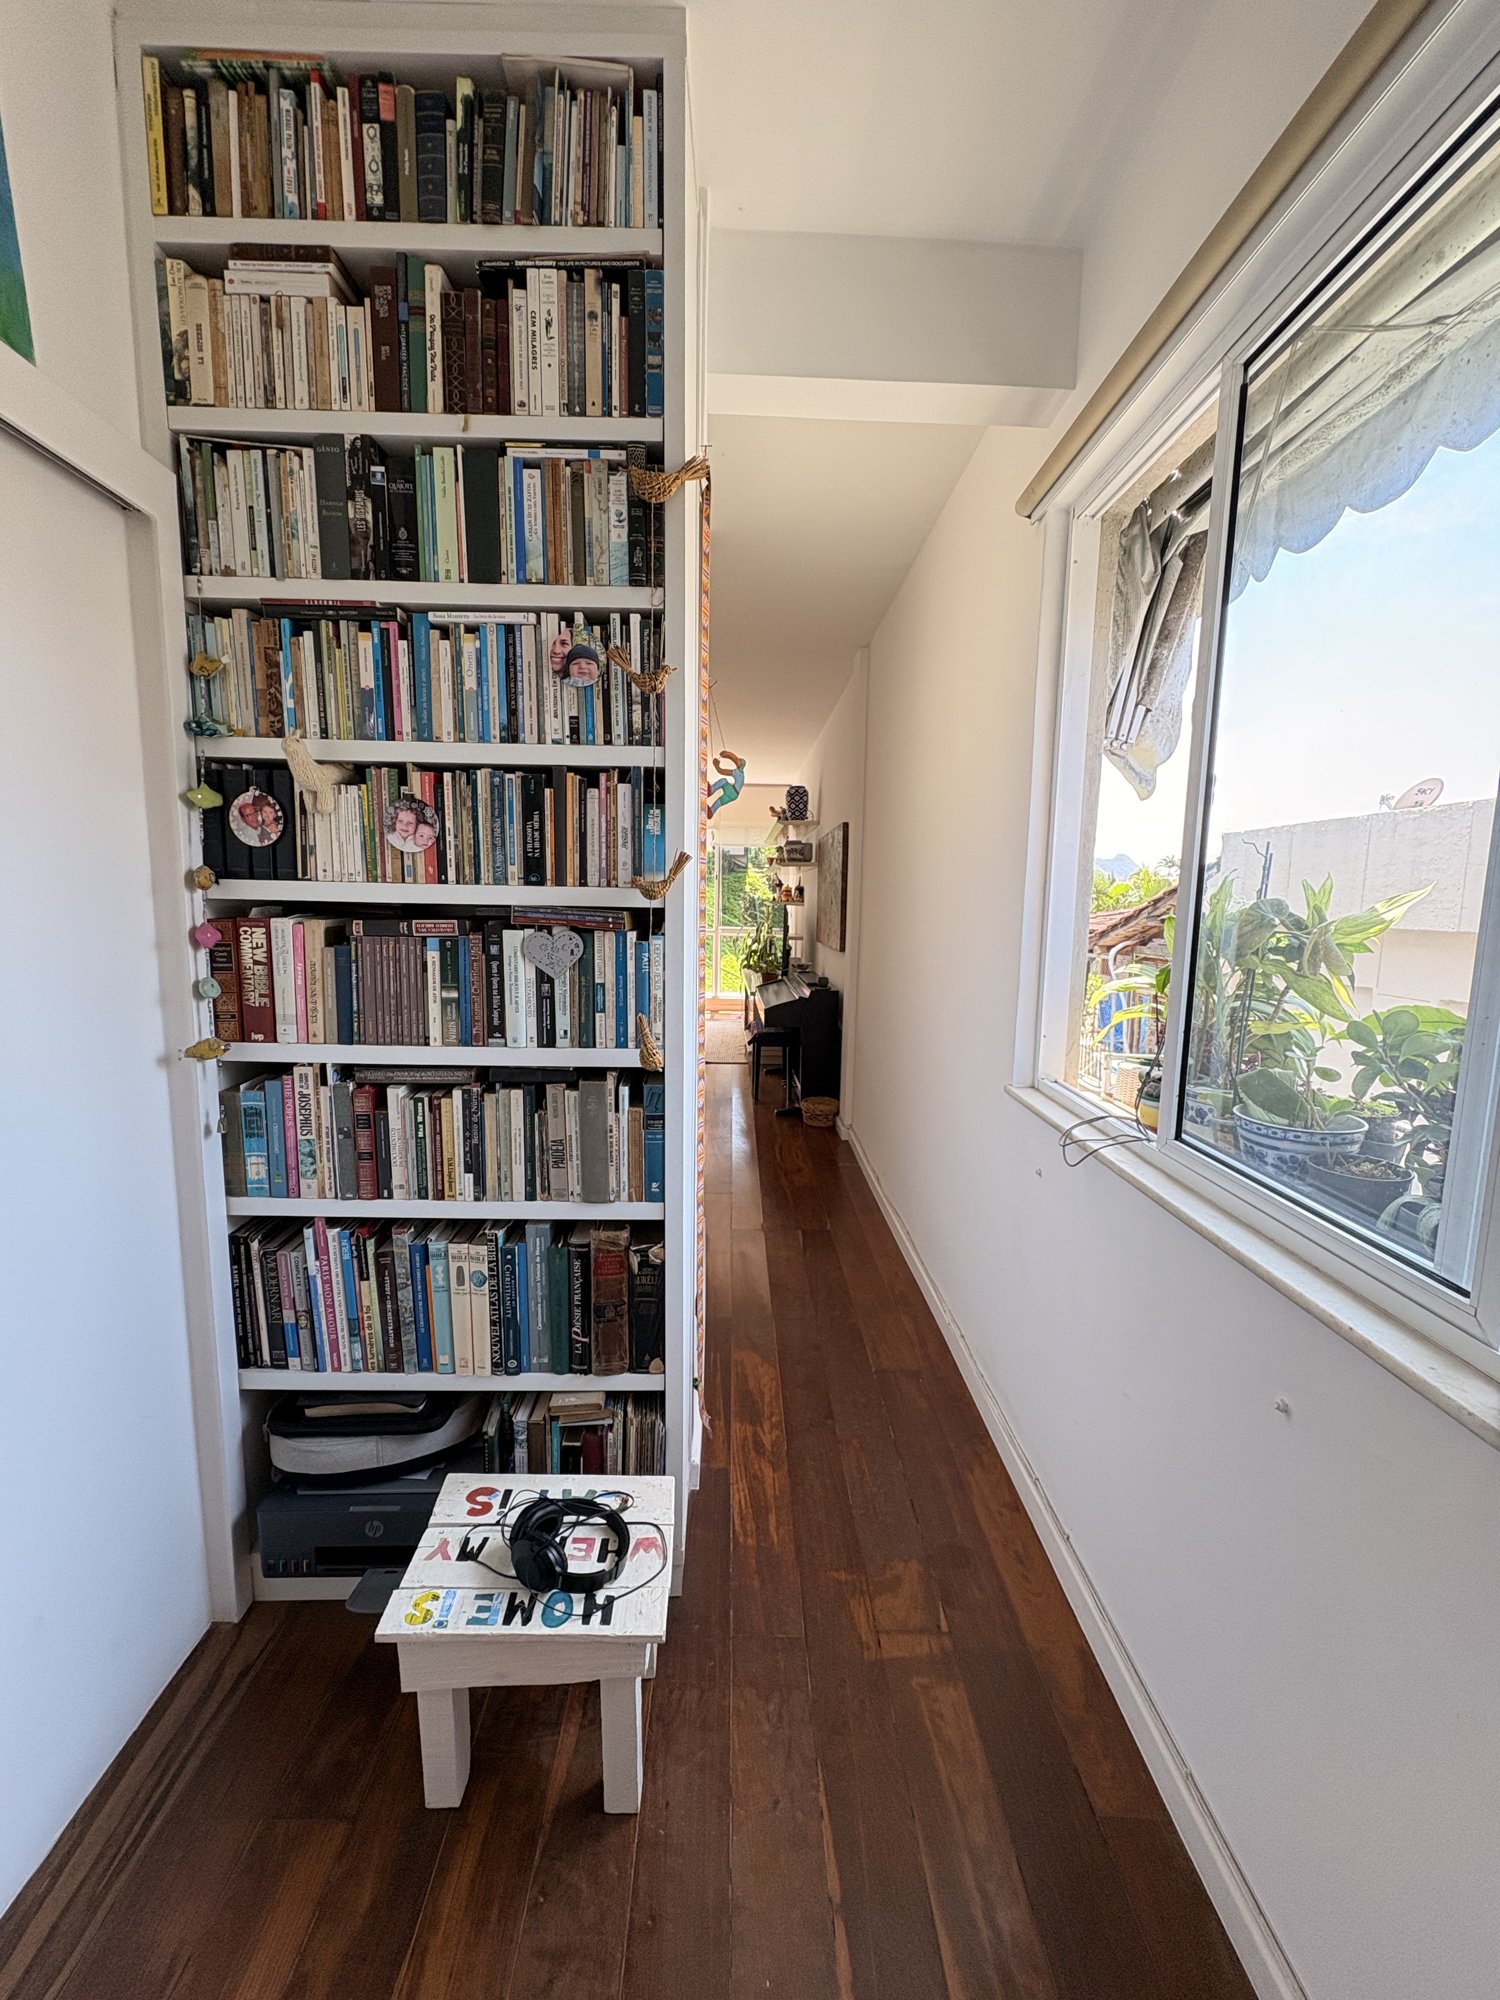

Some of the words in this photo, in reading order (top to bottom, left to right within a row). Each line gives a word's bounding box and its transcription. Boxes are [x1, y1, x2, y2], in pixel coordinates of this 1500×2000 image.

[530, 329, 538, 370] MILAGRES
[354, 489, 365, 519] DISPARUS
[356, 520, 366, 532] LES
[466, 651, 474, 678] Onetti
[1417, 787, 1436, 796] SKY
[251, 927, 267, 962] NEW
[653, 943, 662, 967] DEPOIS
[239, 926, 255, 1007] COMMENTARY
[641, 952, 649, 973] PAUL
[254, 965, 270, 1008] BIBLE
[472, 962, 481, 994] Christian
[653, 970, 662, 991] JESUS
[472, 995, 481, 1021] normal
[472, 1022, 481, 1035] The
[283, 1078, 292, 1097] THE
[285, 1099, 294, 1127] POPES
[298, 1090, 313, 1137] JOSEPHUS
[471, 1114, 479, 1122] de
[472, 1124, 480, 1144] Bento
[550, 1138, 566, 1169] PAIDEIA
[342, 1239, 350, 1260] BERLIN
[487, 1233, 496, 1261] BIBLE
[266, 1255, 279, 1302] MODERN
[294, 1256, 302, 1287] COMPLETE
[320, 1255, 329, 1280] PARIS
[488, 1262, 497, 1275] LA
[323, 1283, 331, 1305] MON
[489, 1277, 498, 1290] DE
[504, 1264, 513, 1319] CHRISTIANITY
[573, 1258, 583, 1305] FRANÇAISE
[271, 1303, 282, 1324] ART
[364, 1305, 372, 1314] foi
[490, 1291, 499, 1322] ATLAS
[326, 1307, 336, 1340] AMOUR
[366, 1322, 373, 1331] de
[385, 1299, 394, 1348] ORCHESTRATION
[572, 1306, 589, 1344] POÉSIE
[366, 1332, 375, 1361] lumières
[490, 1322, 501, 1363] NOUVEL
[574, 1342, 582, 1354] LA
[366, 1520, 385, 1539] hp
[424, 1536, 491, 1563] MY
[465, 1590, 615, 1629] HOME
